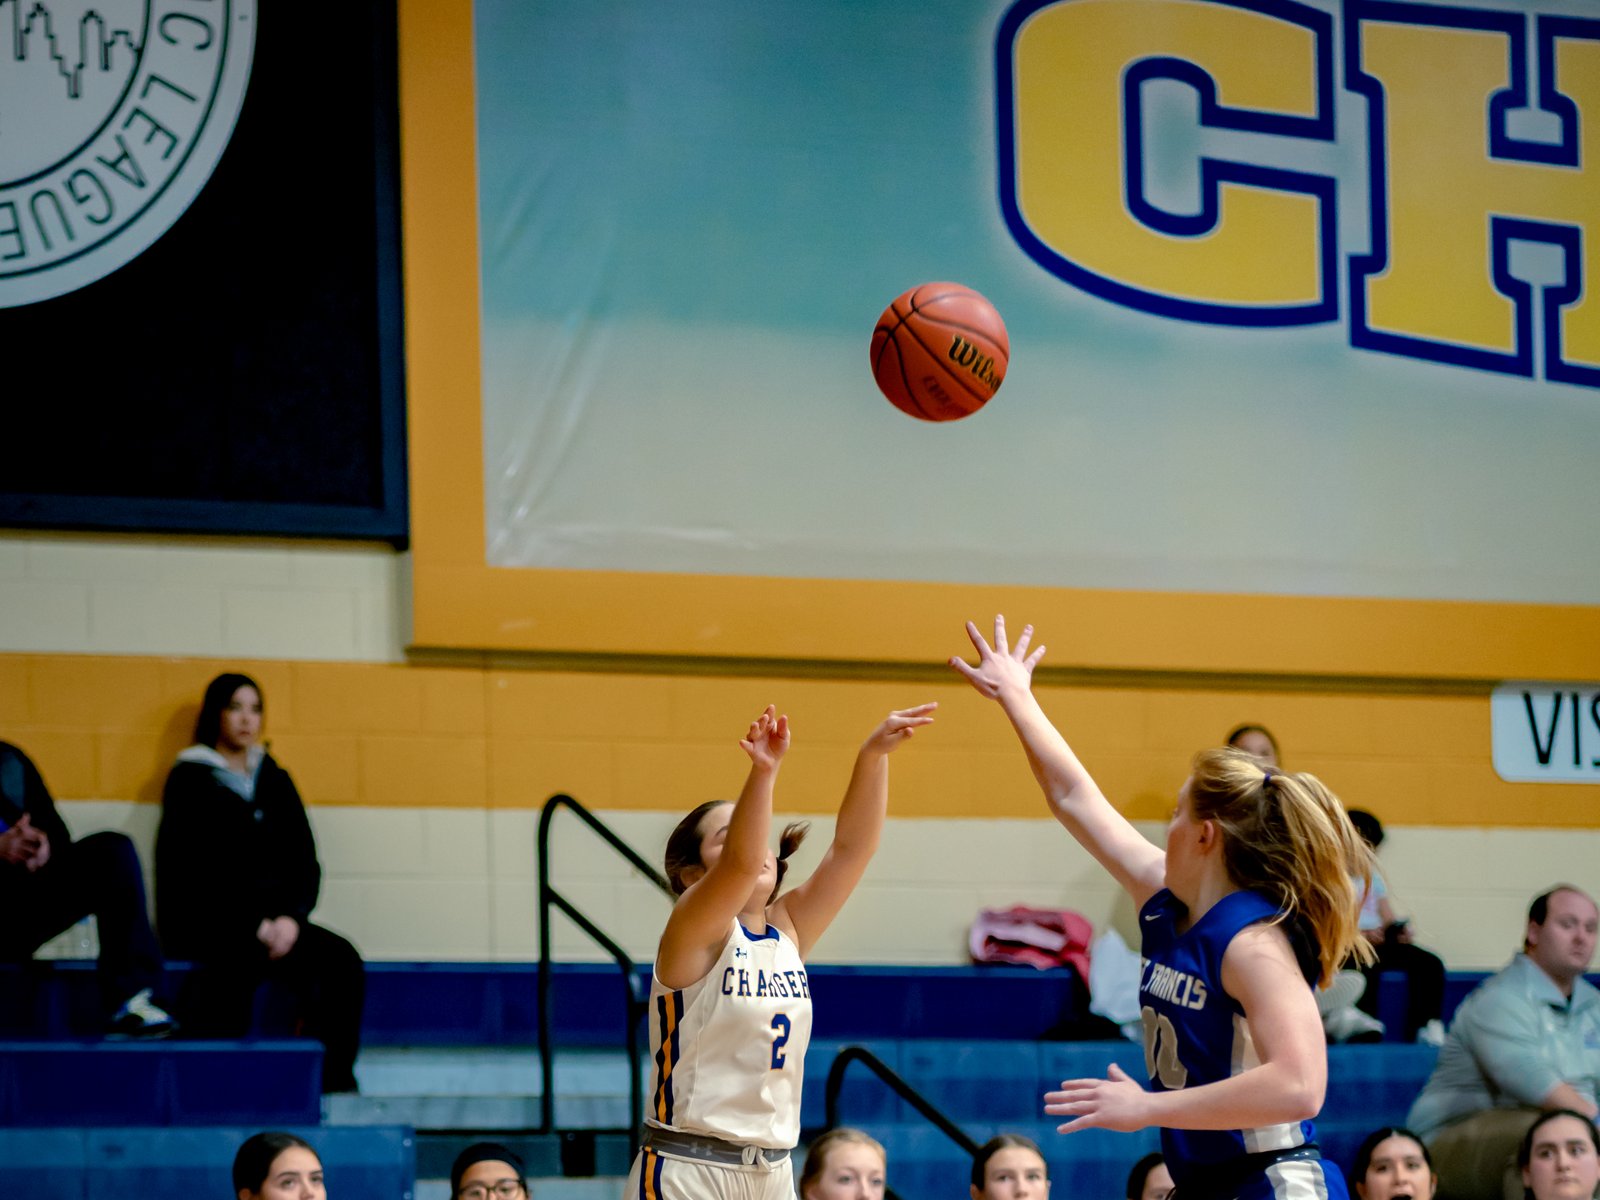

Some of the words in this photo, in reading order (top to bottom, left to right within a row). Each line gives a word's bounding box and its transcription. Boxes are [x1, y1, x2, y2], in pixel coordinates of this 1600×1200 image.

[0, 74, 199, 261] LEAGUE
[995, 0, 1600, 389] CH
[770, 1012, 792, 1071] 2
[1146, 962, 1208, 1011] FRANCIS
